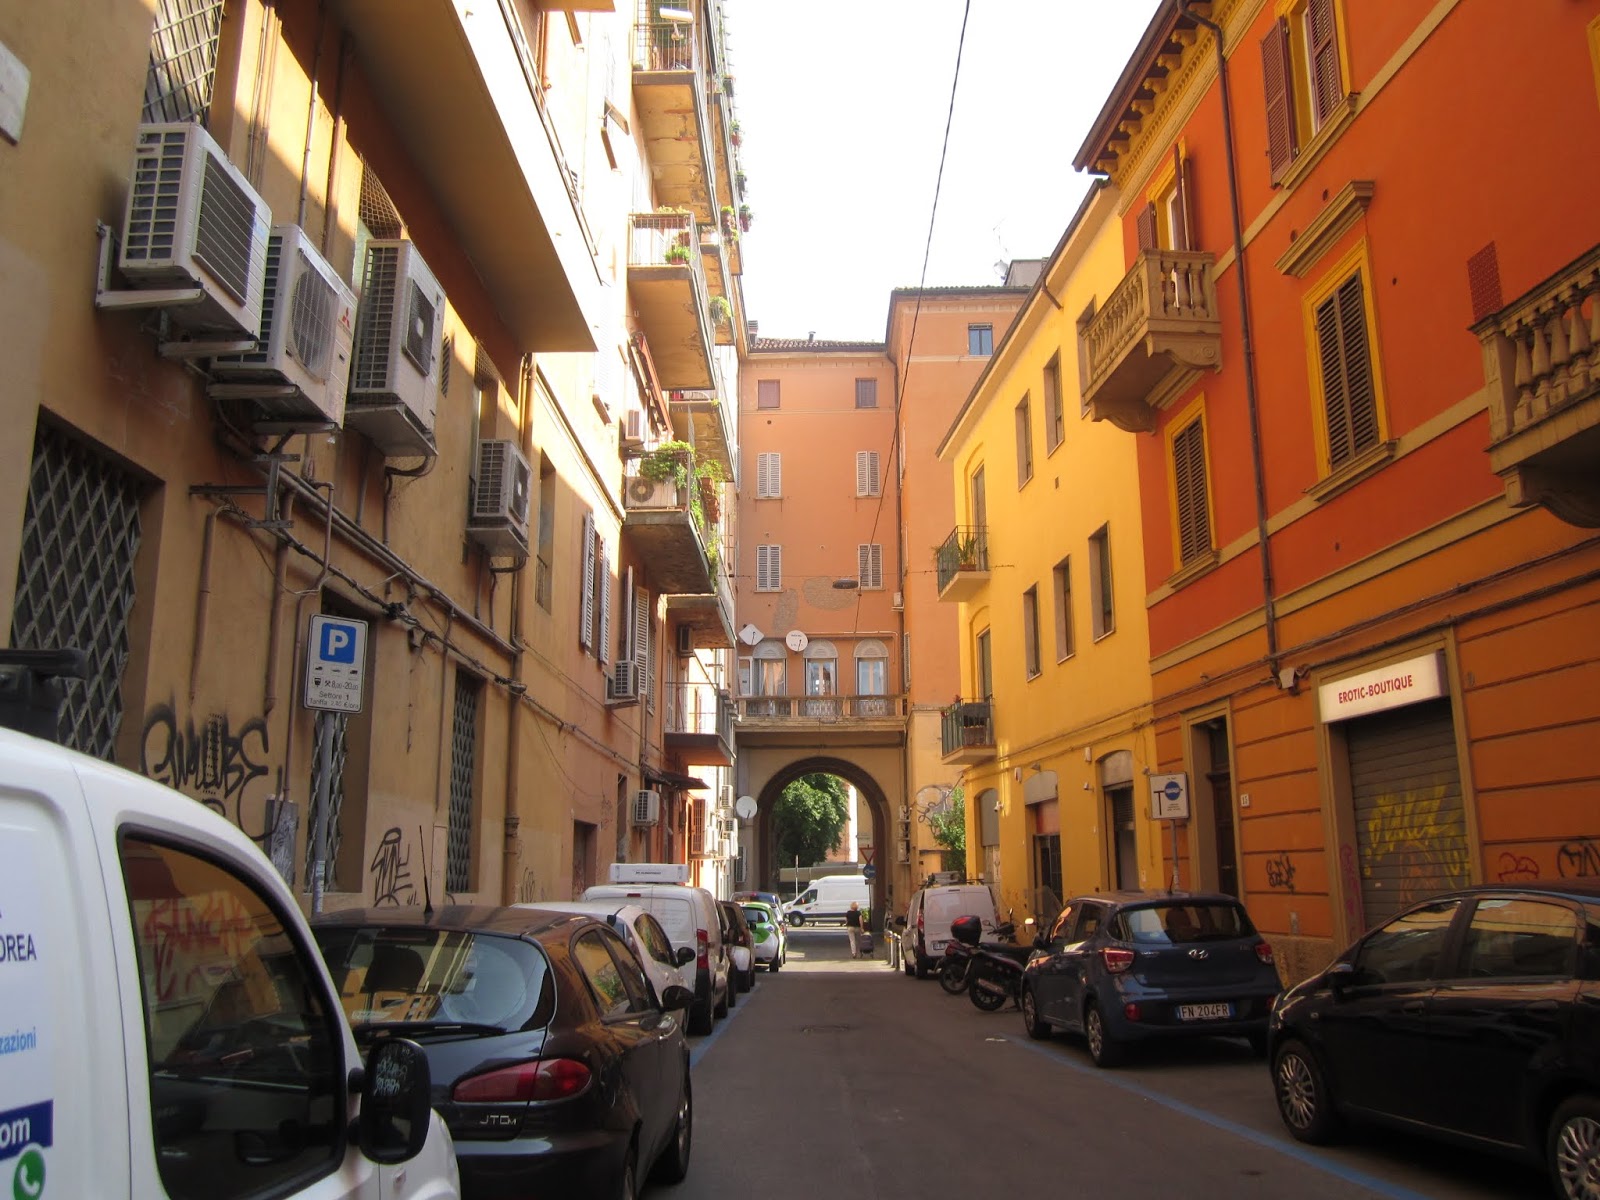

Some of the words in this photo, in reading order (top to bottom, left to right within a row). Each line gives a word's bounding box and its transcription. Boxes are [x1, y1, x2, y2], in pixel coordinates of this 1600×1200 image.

[328, 629, 349, 656] P
[319, 691, 342, 700] Settore
[1338, 675, 1413, 704] EROTIC-BOUTIQUE
[1181, 1006, 1194, 1018] FN
[1198, 1004, 1228, 1017] 204FR
